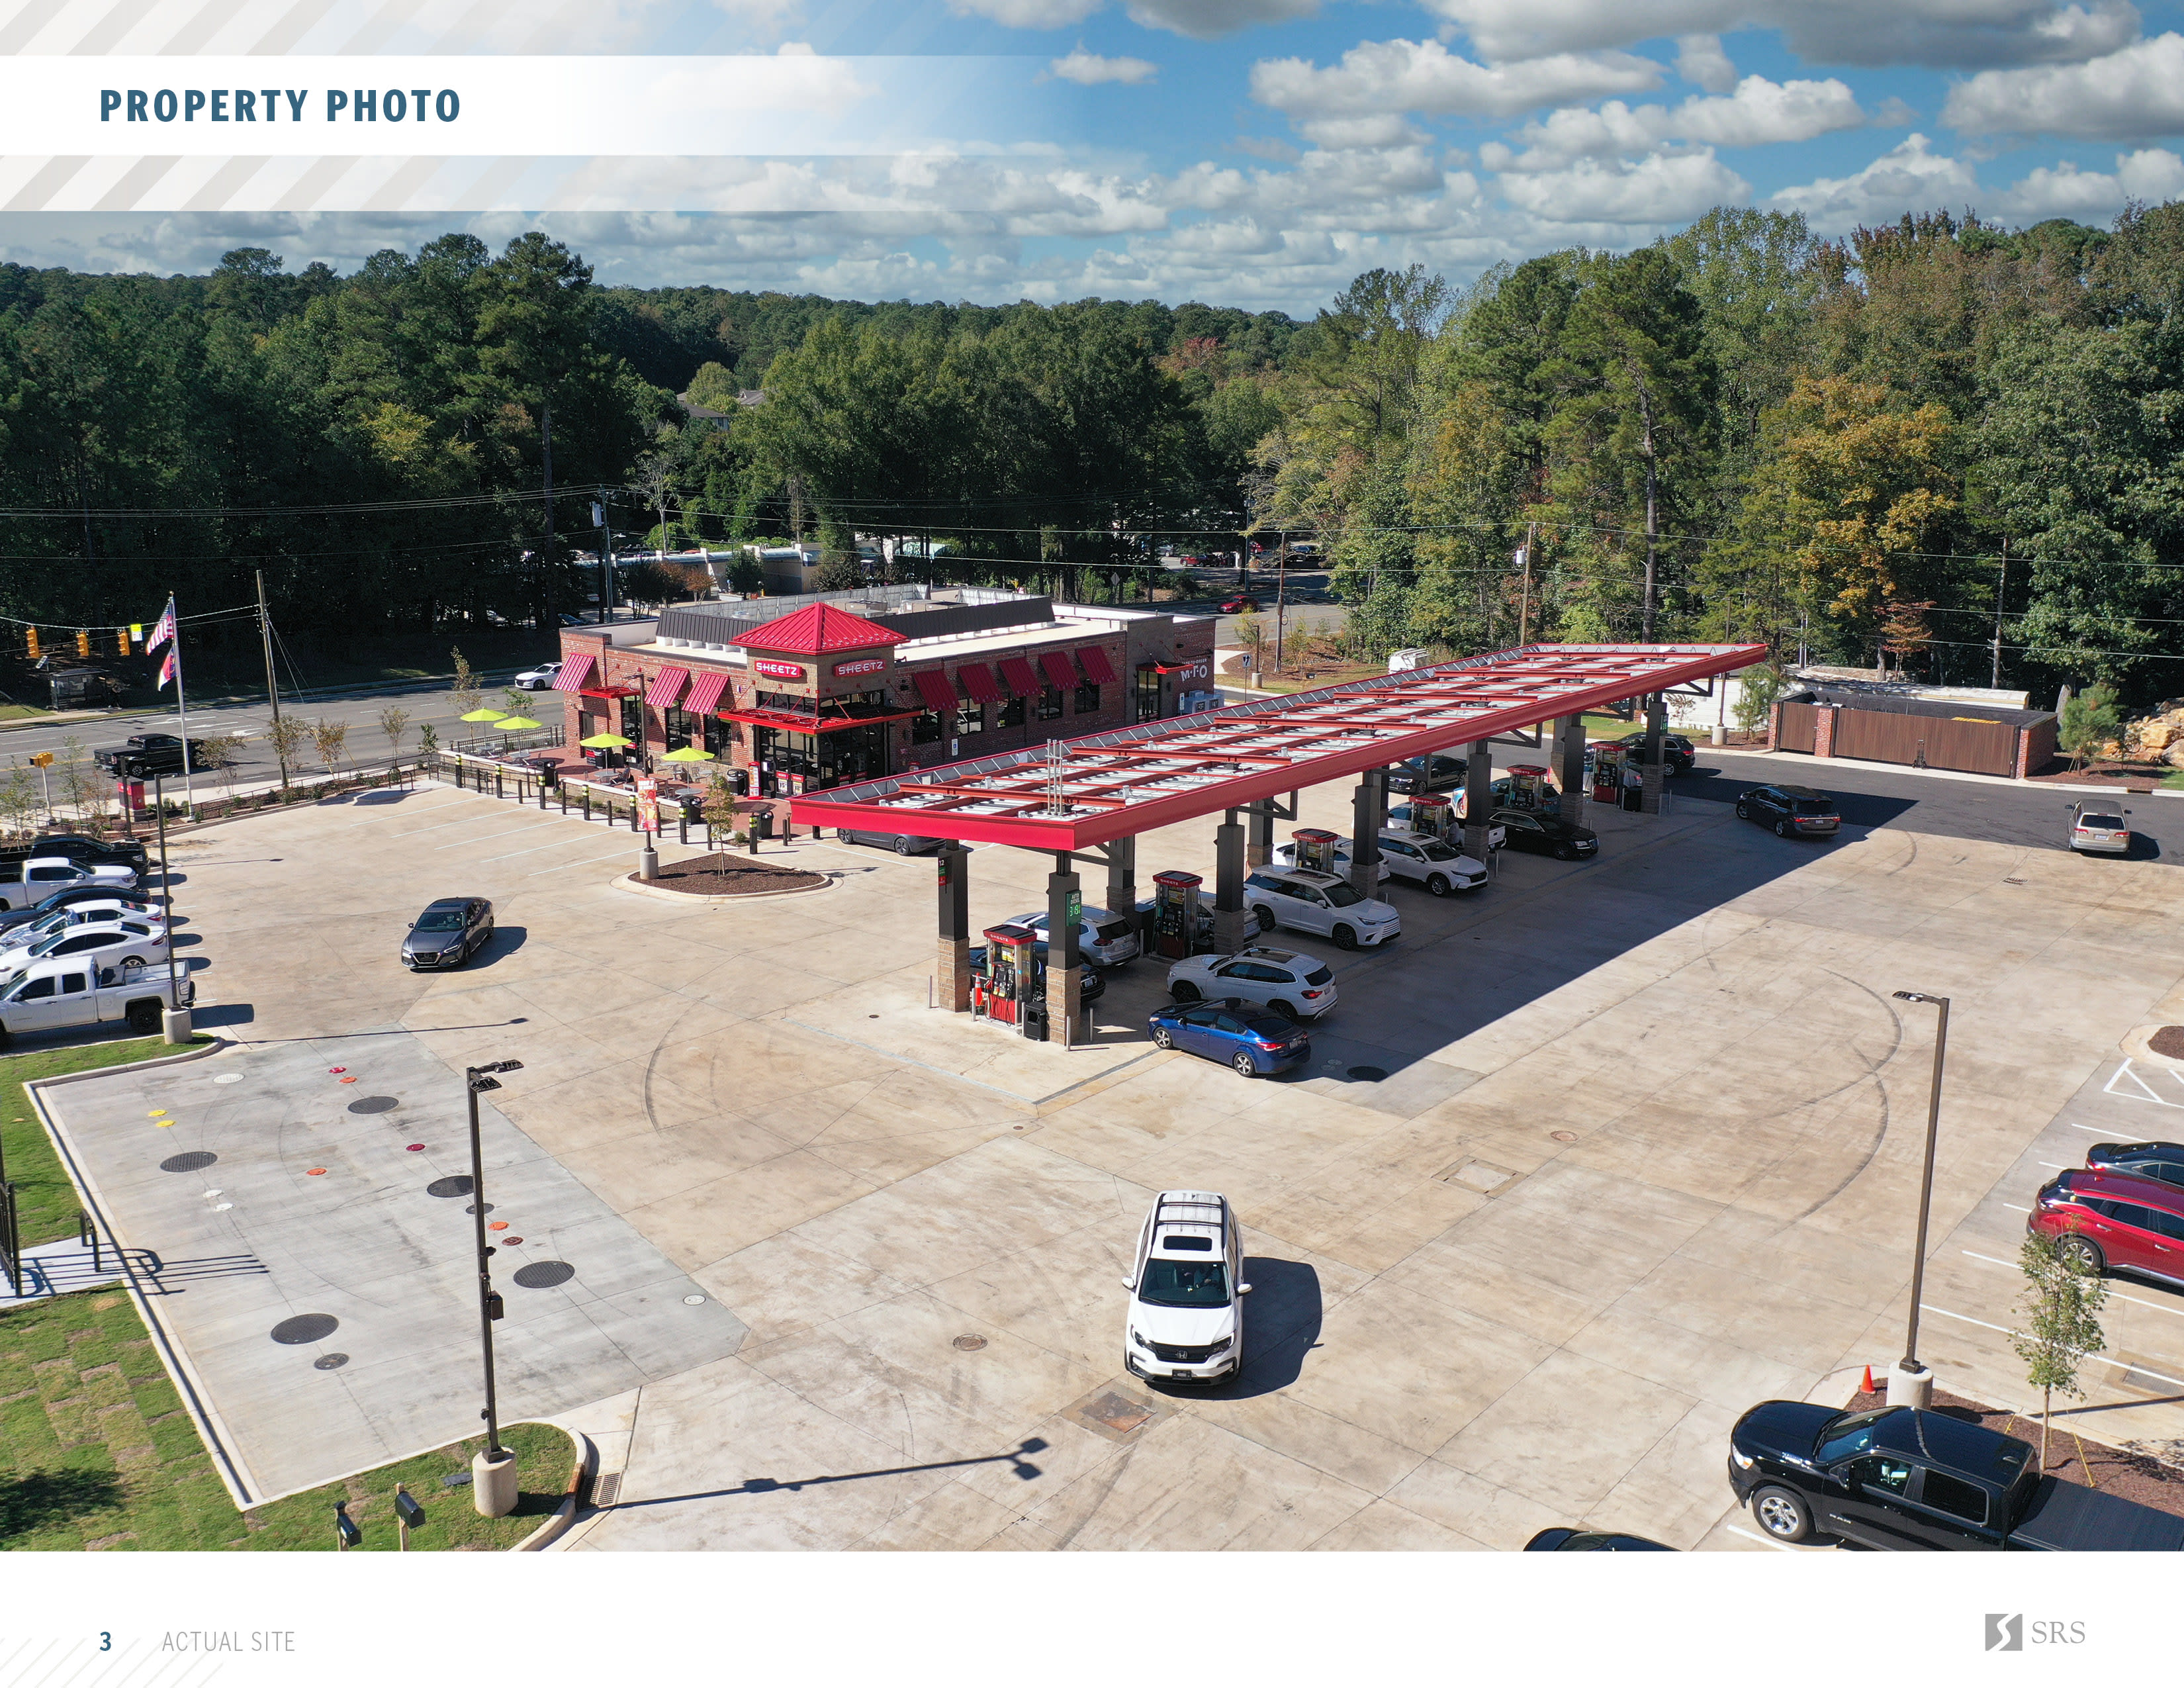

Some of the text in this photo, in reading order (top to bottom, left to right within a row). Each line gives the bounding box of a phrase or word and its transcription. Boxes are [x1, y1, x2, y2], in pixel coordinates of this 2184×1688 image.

[756, 662, 797, 675] SHEETZ
[838, 661, 884, 675] SHEETZ
[1829, 1513, 1852, 1524] RAM
